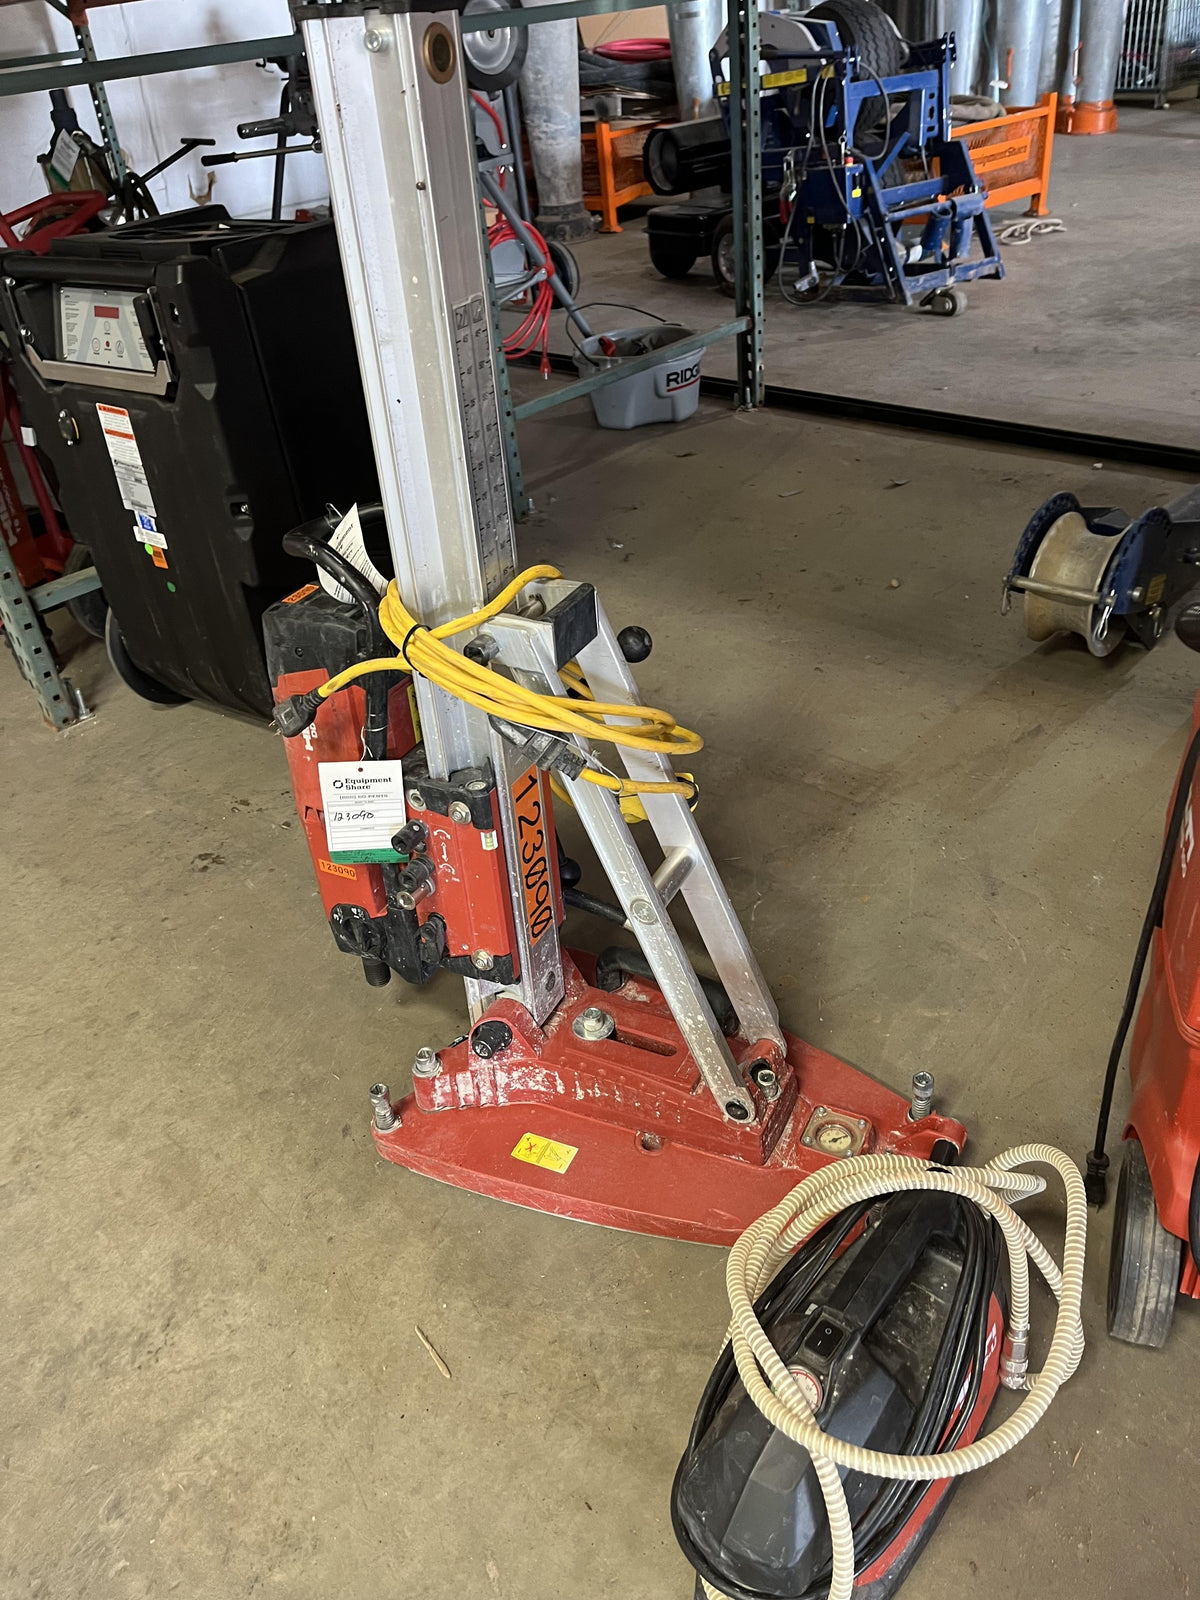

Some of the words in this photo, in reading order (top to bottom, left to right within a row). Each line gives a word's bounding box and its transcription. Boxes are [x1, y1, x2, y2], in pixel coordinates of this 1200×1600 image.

[345, 777, 392, 785] Equipment
[515, 774, 553, 938] 123090
[321, 861, 356, 878] 123090
